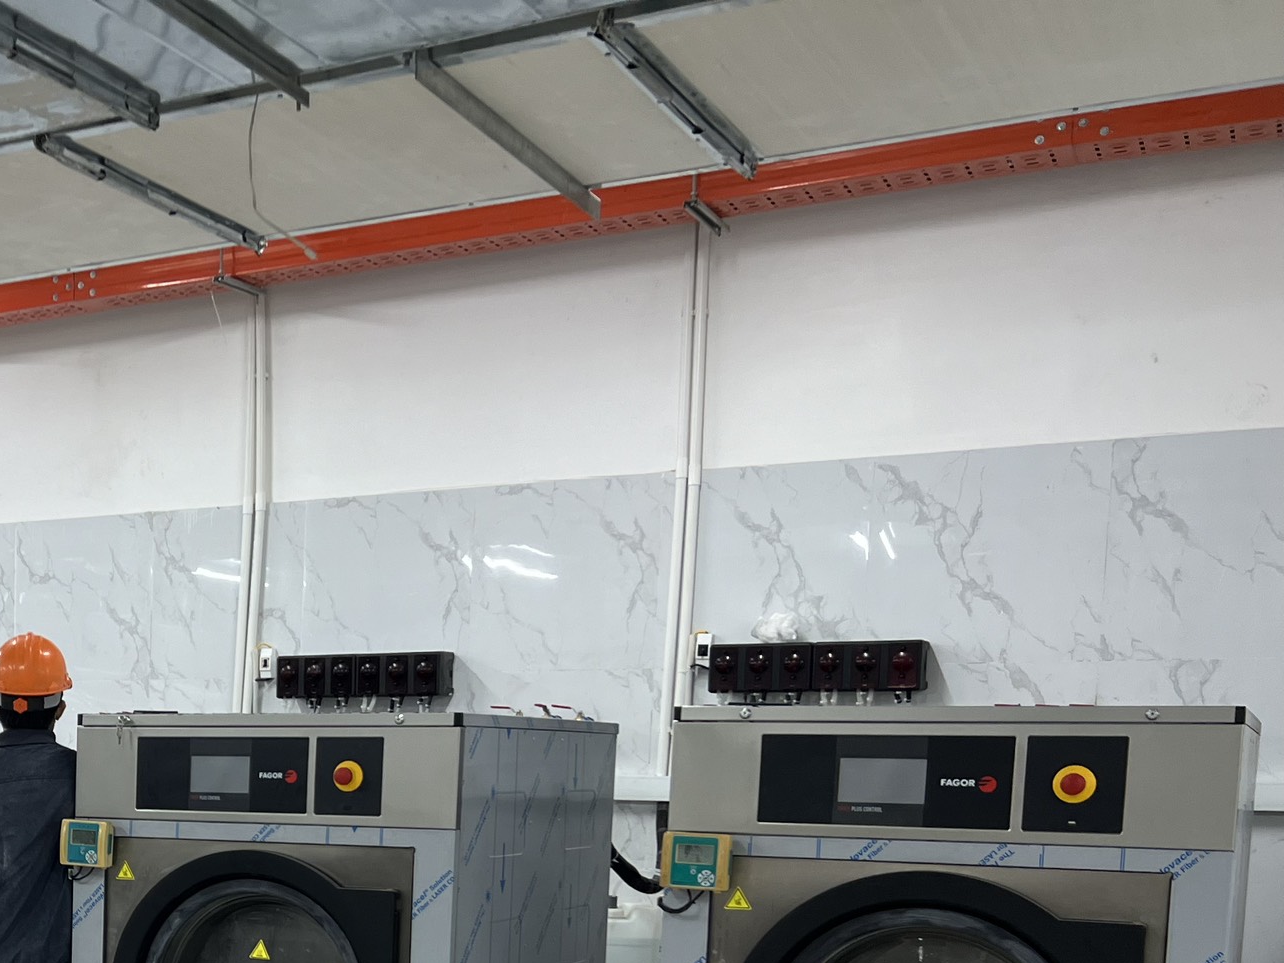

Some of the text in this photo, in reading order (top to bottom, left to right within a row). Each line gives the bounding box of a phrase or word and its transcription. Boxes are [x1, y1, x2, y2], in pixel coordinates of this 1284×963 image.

[259, 771, 283, 779] FAGOR
[940, 778, 975, 787] FAGOR
[1180, 857, 1199, 873] Fiber
[429, 869, 452, 891] Solution
[431, 884, 449, 900] LASER
